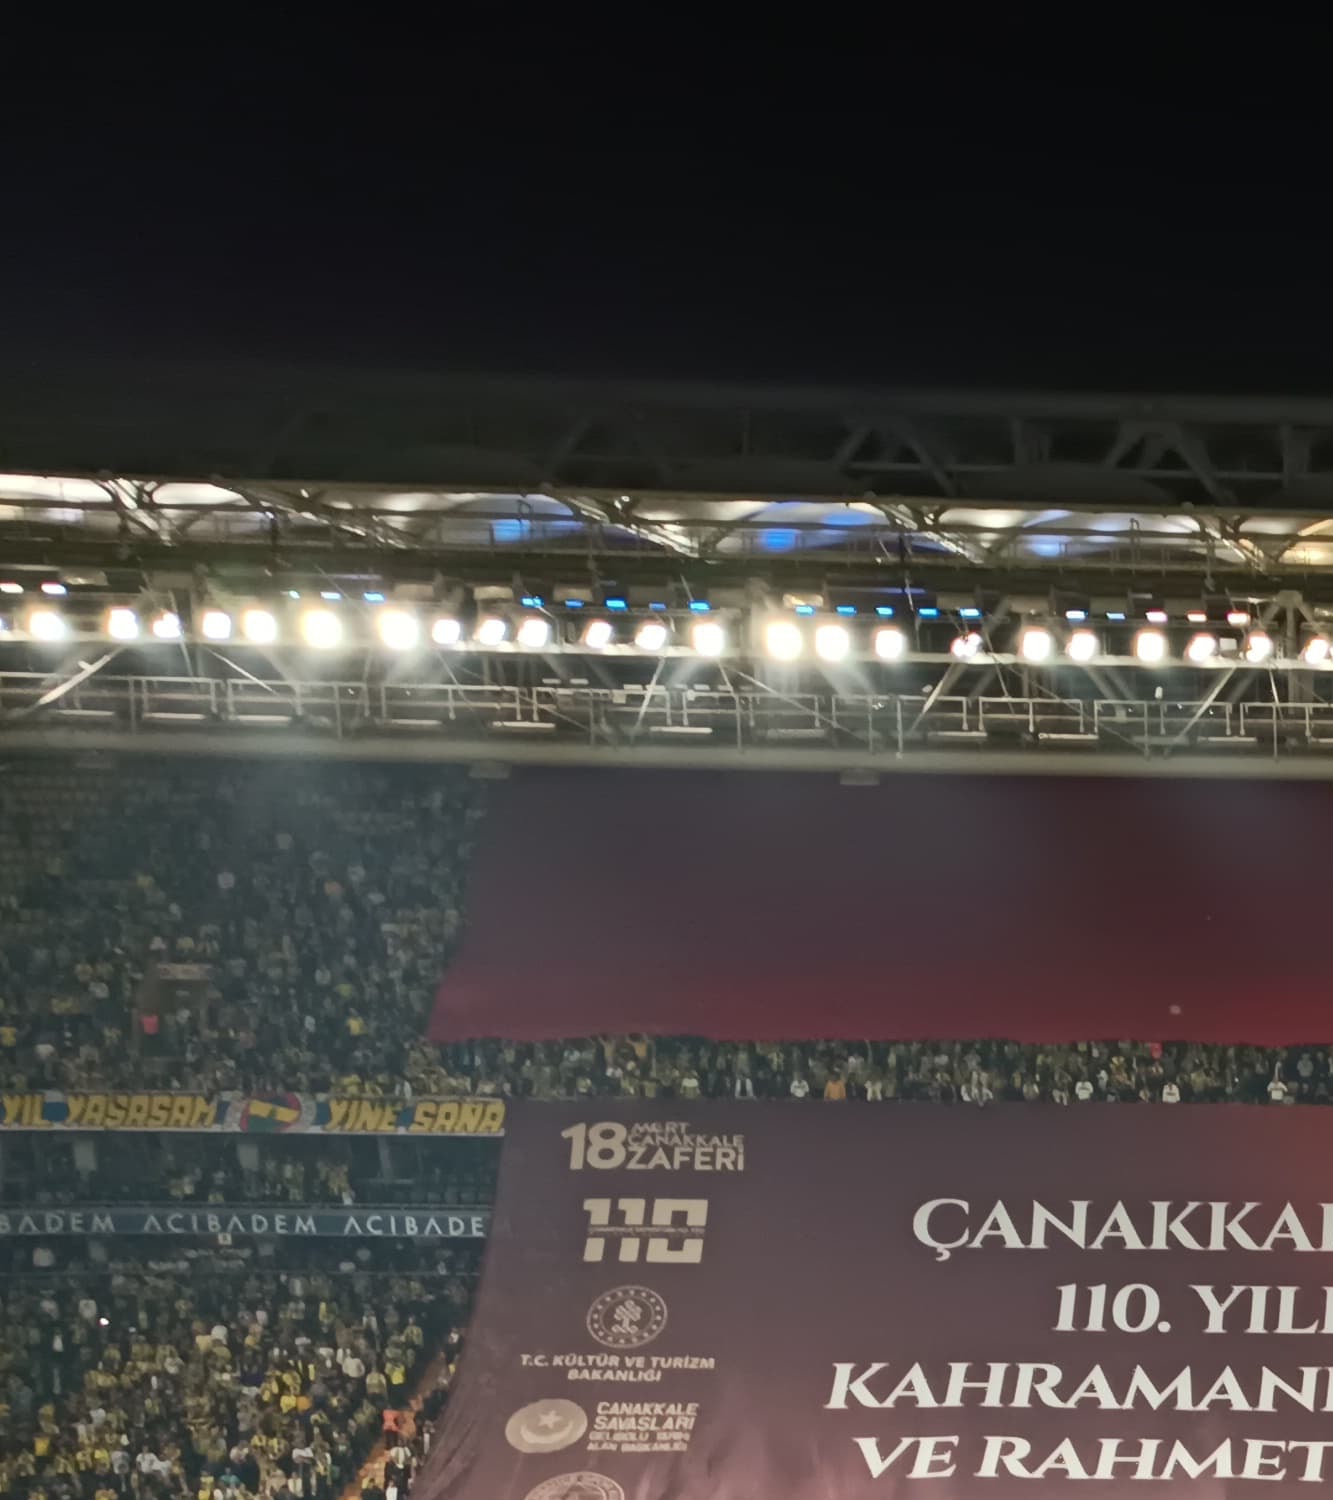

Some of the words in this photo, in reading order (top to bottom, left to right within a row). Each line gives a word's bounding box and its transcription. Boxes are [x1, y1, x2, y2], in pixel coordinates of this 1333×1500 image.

[561, 1122, 627, 1170] 18
[625, 1145, 744, 1170] ZAFERİ
[143, 1213, 318, 1236] ACIBADEM
[343, 1215, 487, 1238] ACIBADE
[583, 1198, 708, 1262] 110
[1053, 1283, 1172, 1333] 110.
[520, 1354, 549, 1367] T.C.
[552, 1353, 620, 1368] KÜLTÜR
[625, 1356, 645, 1368] VE
[650, 1355, 715, 1369] TURİZM
[568, 1369, 662, 1382] BAKANLIĞI
[853, 1436, 959, 1479] VE
